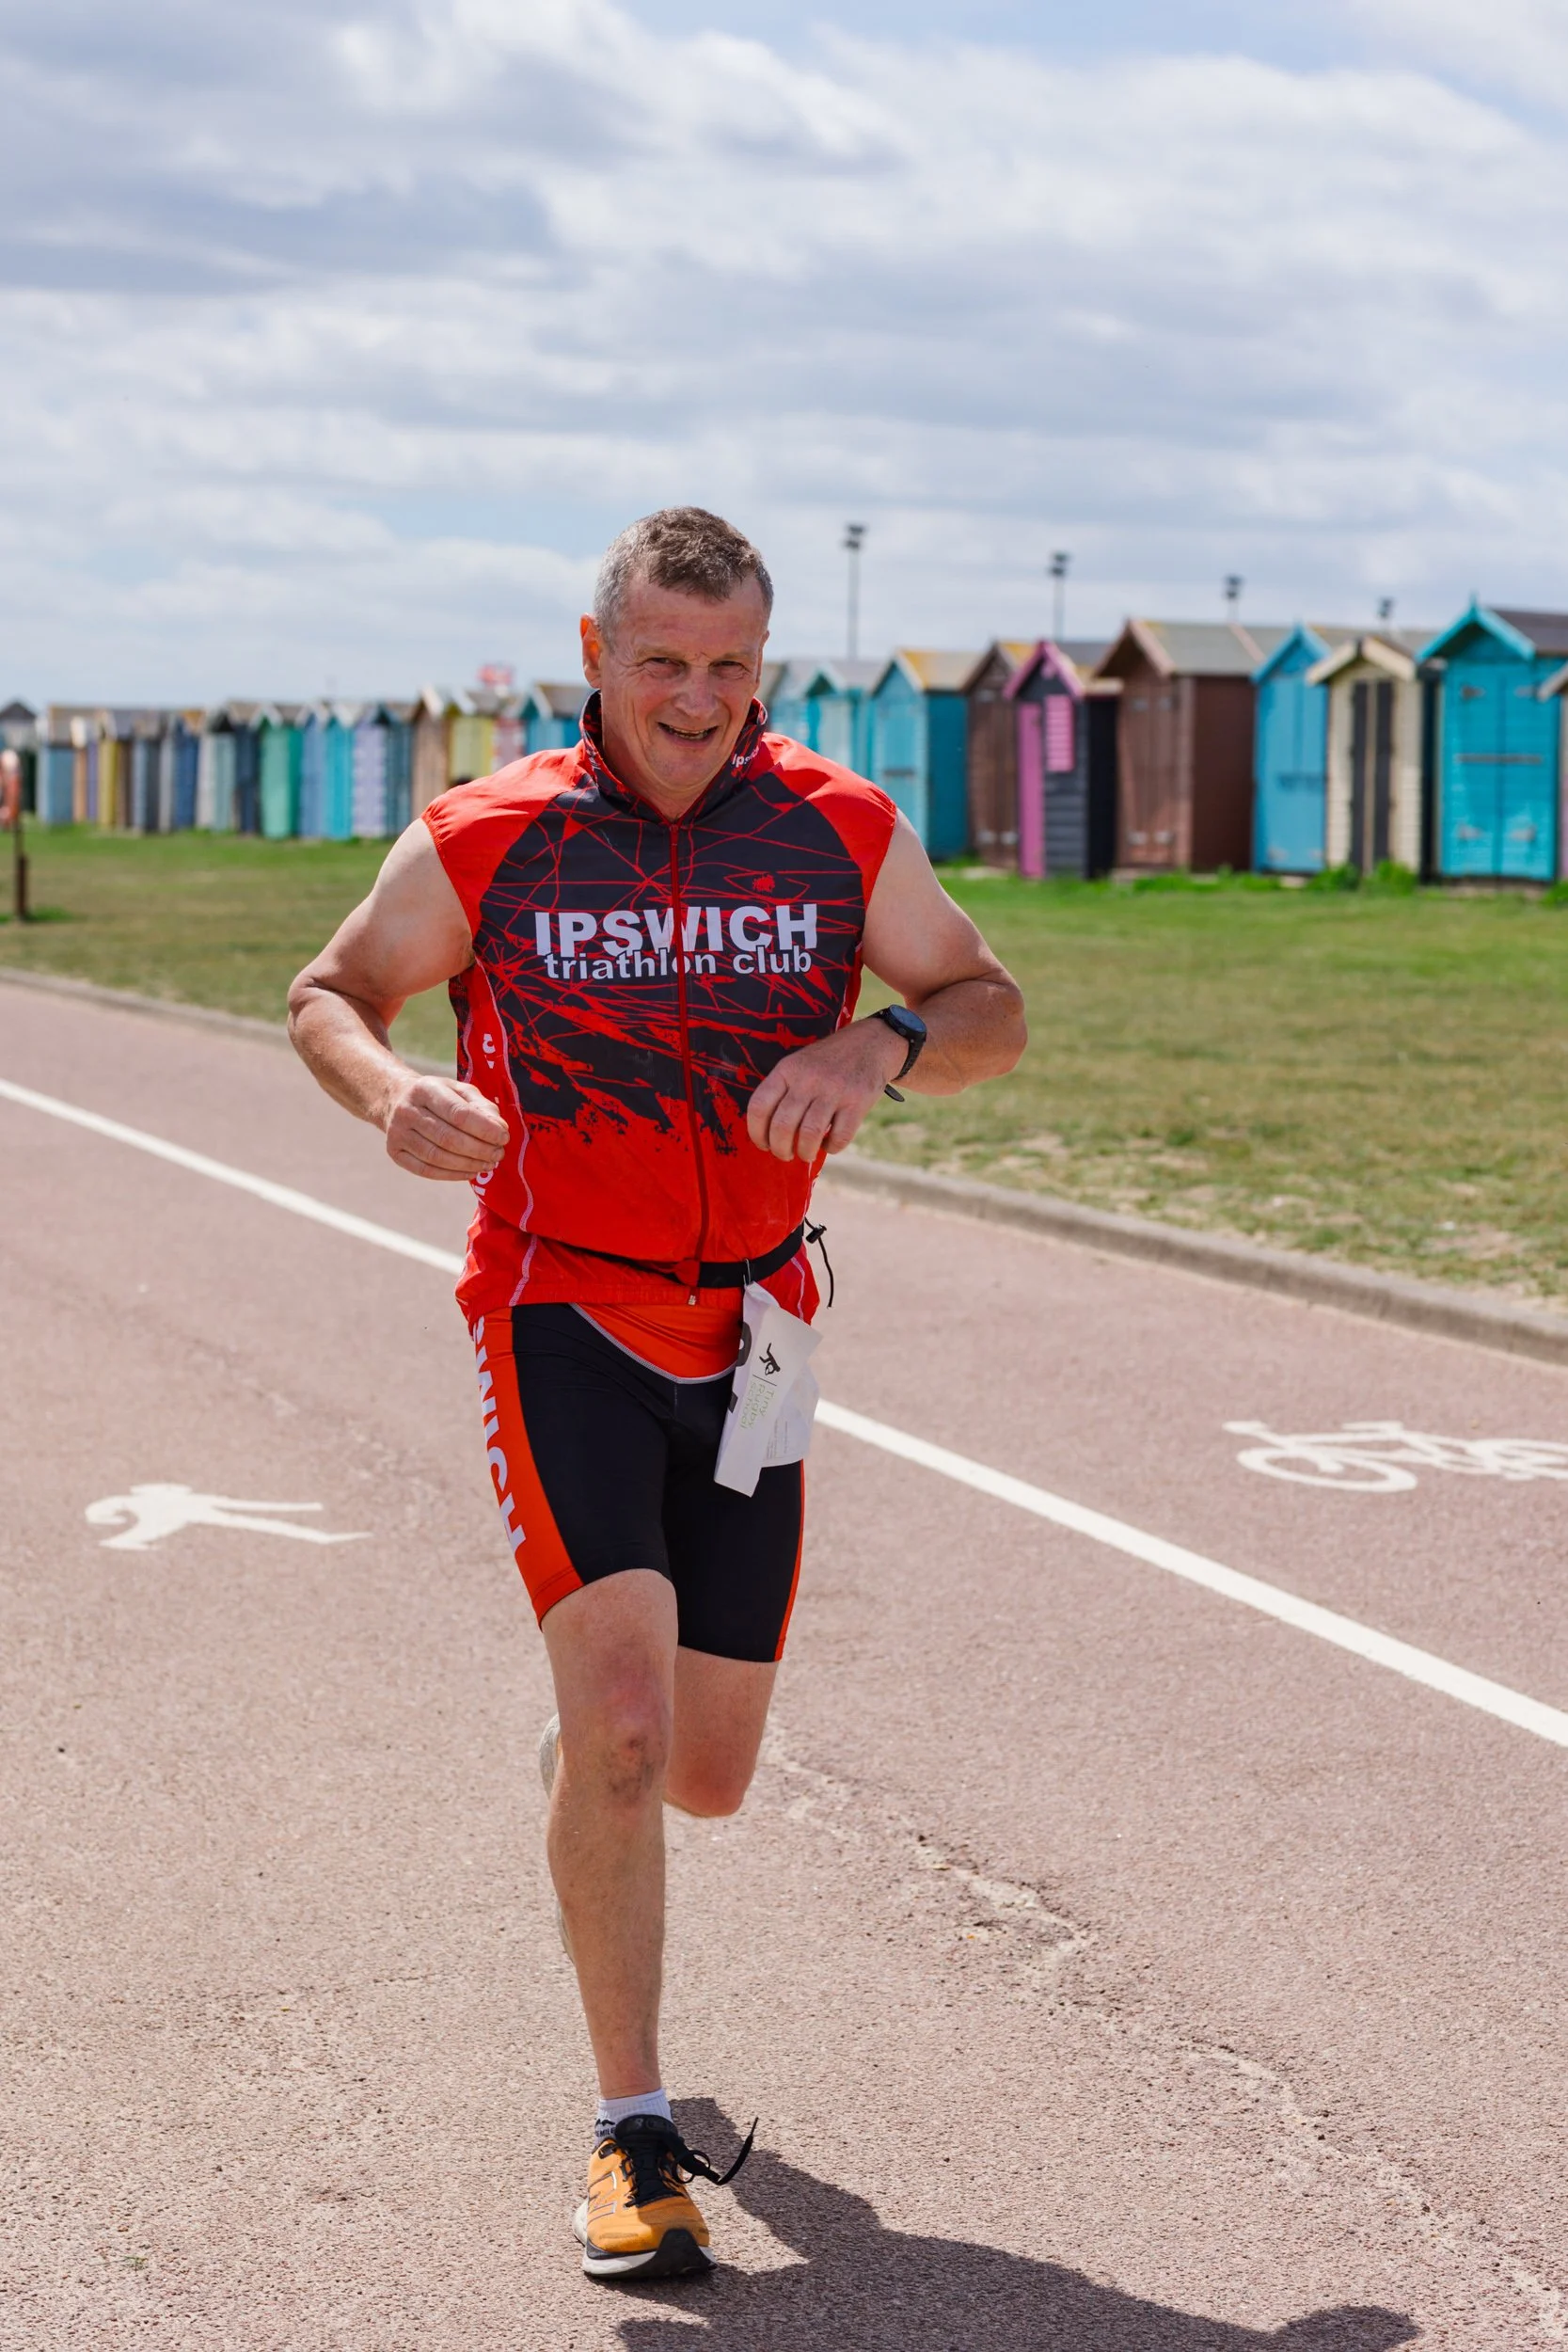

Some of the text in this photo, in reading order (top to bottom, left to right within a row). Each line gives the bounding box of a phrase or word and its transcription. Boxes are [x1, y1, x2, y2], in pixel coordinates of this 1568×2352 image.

[534, 904, 817, 958] IPSWICH
[544, 945, 813, 979] triathlon club
